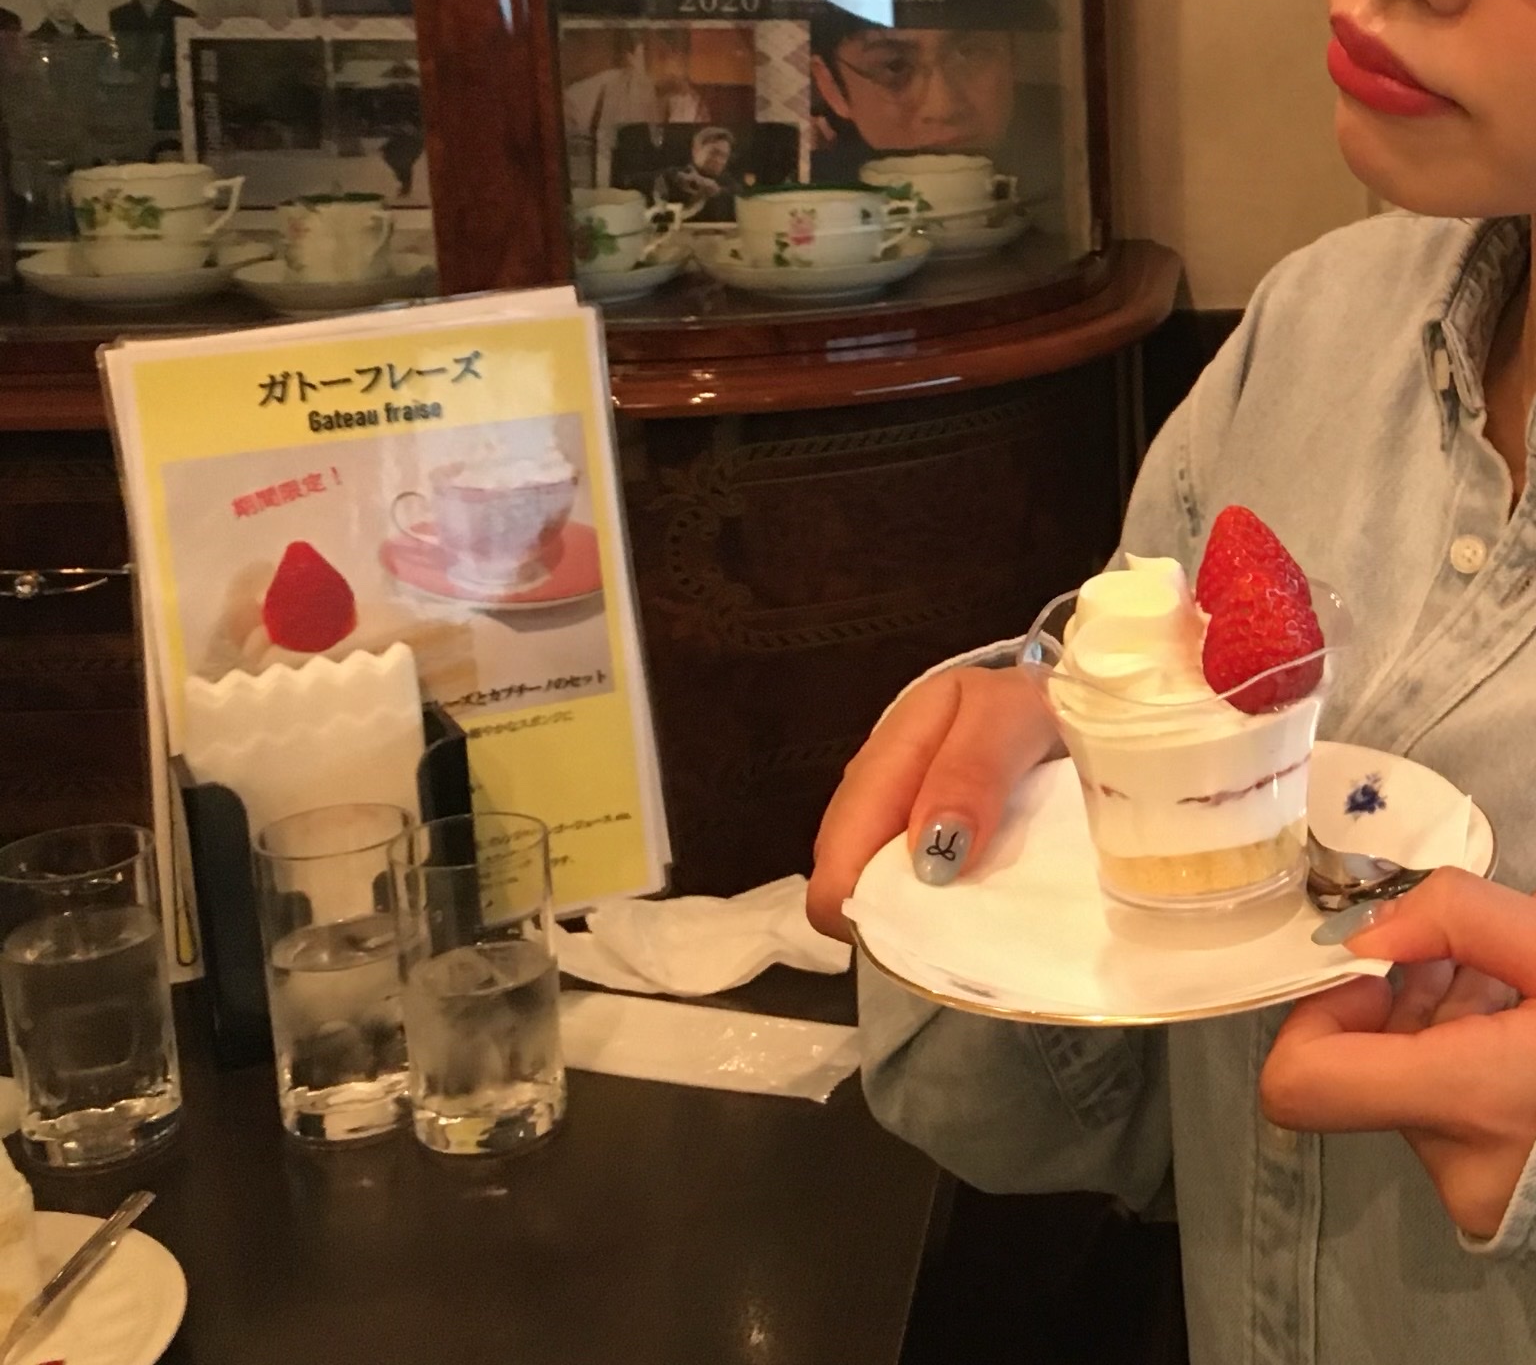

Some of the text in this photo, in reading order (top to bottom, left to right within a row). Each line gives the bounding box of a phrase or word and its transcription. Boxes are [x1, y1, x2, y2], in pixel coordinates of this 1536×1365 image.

[258, 350, 482, 407] ガトーフレーズ
[308, 400, 443, 433] Gateau fraise
